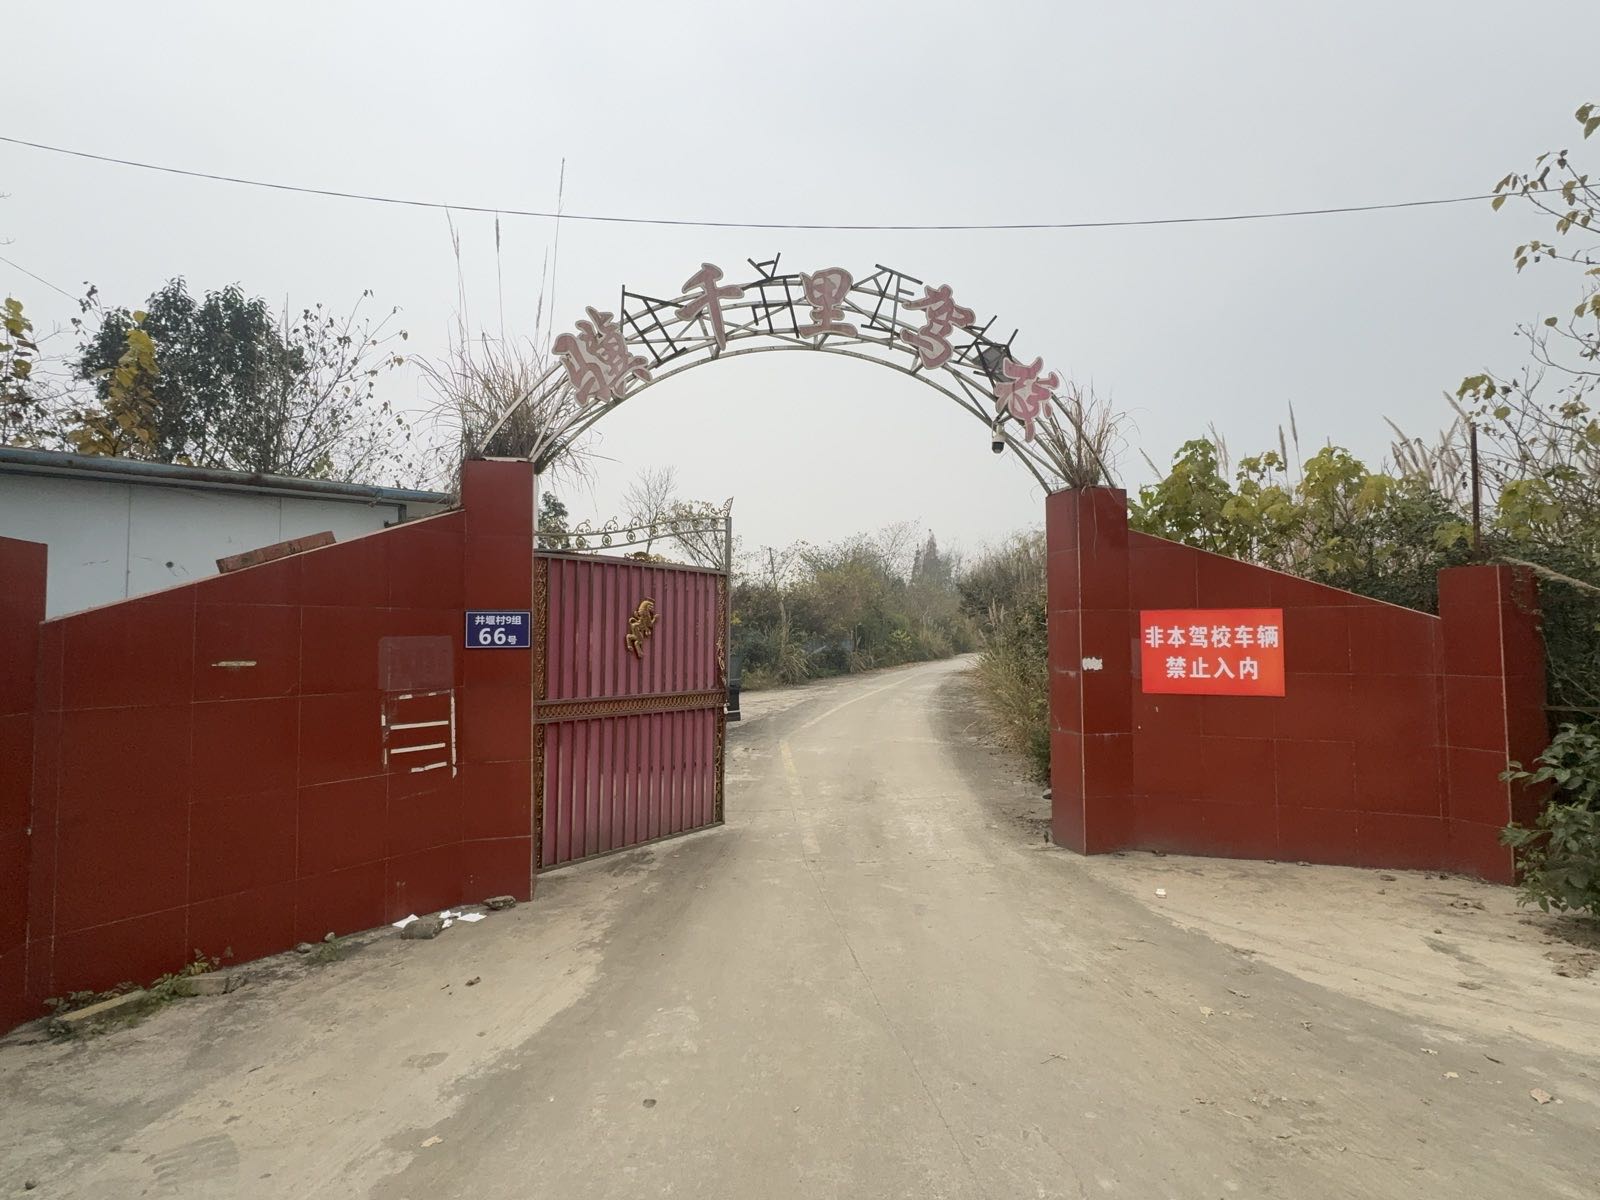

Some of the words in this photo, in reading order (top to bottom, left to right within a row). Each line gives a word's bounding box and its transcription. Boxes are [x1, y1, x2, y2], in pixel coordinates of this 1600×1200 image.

[479, 628, 517, 645] 66号
[1145, 625, 1279, 648] 非本驾校车辆
[1166, 656, 1259, 680] 禁止入内
